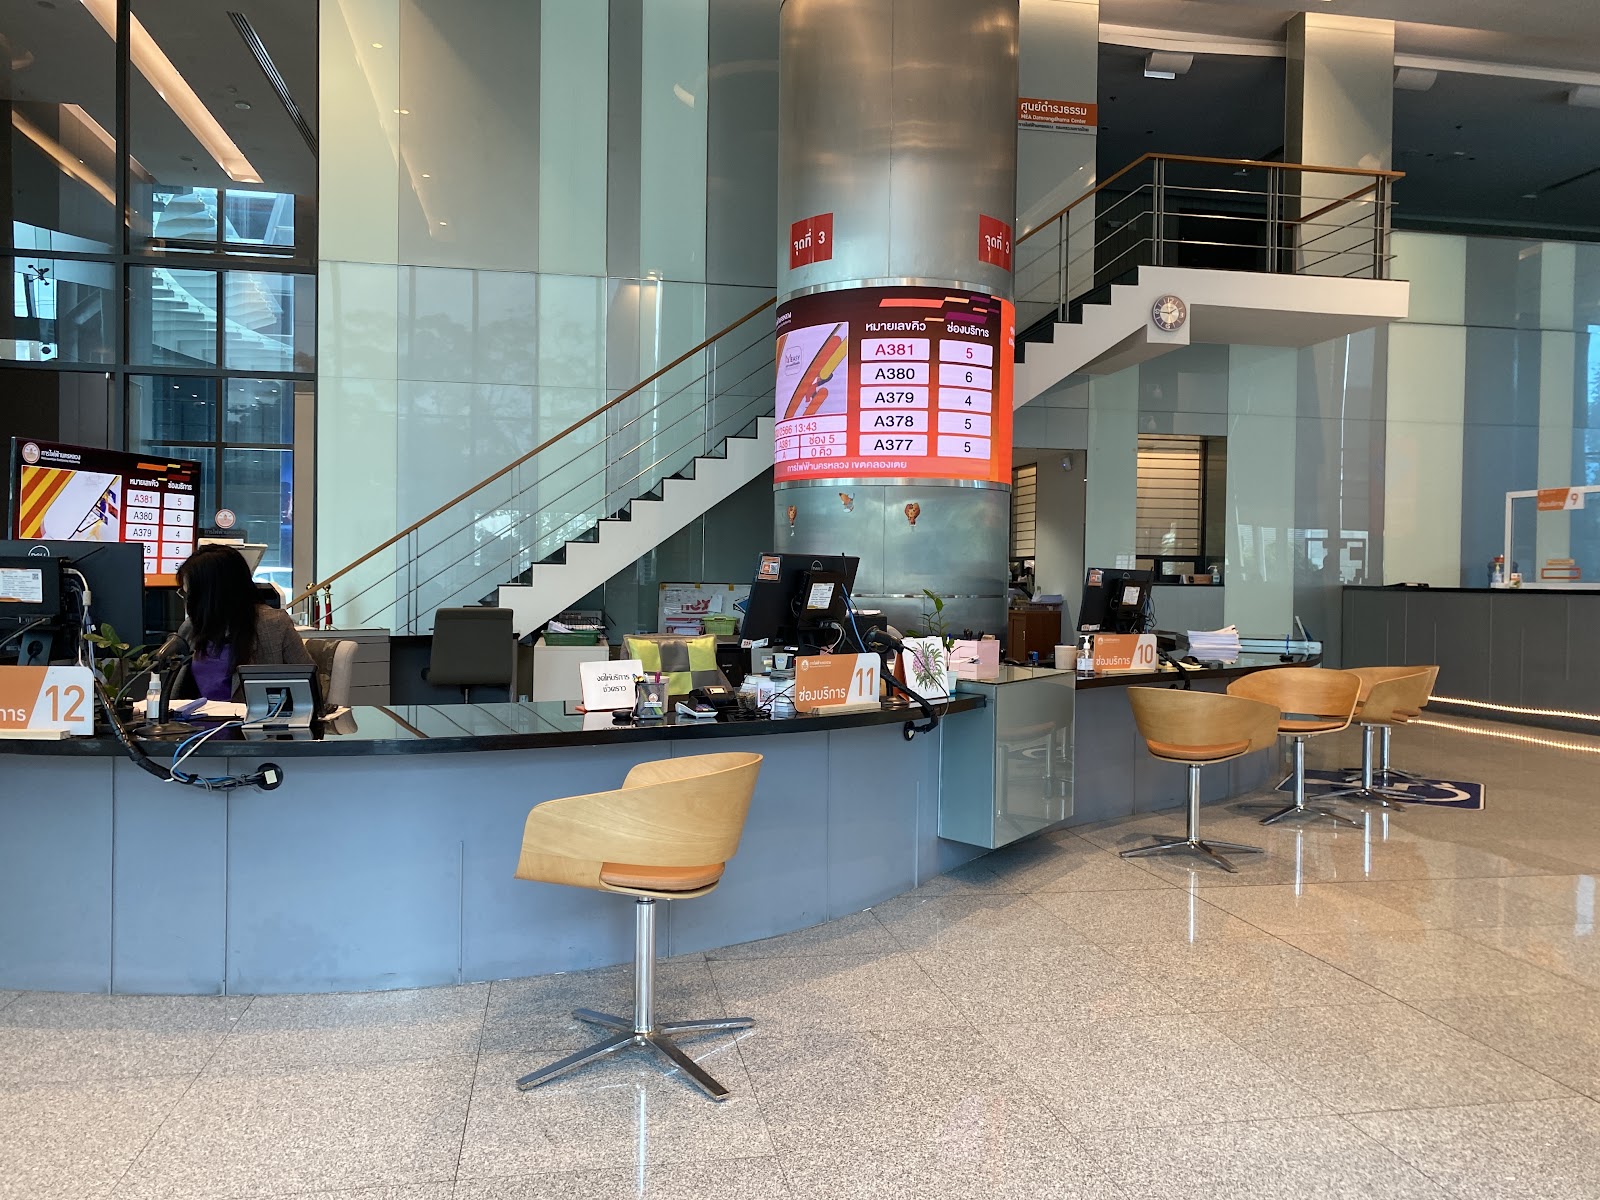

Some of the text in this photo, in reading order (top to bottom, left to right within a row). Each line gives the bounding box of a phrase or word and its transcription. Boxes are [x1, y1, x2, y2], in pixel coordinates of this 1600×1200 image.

[1021, 101, 1087, 116] ศูนย์ดำรงธรรม
[794, 228, 826, 256] จุดที่ 3
[984, 232, 1010, 254] จุดที่ 3
[865, 320, 926, 332] หมายเลขคิว
[946, 321, 990, 338] ช่องบริการ
[875, 343, 914, 356] A381
[966, 347, 973, 359] 5
[875, 368, 915, 380] A380
[965, 371, 973, 383] 6
[875, 392, 914, 404] A379
[964, 395, 972, 406] 4
[794, 421, 817, 433] 13:43
[874, 415, 914, 427] A378
[964, 418, 972, 430] 5
[809, 433, 835, 445] ช่อง 5
[874, 439, 914, 451] A377
[811, 446, 832, 457] 0 คิว
[964, 441, 971, 453] 5
[787, 460, 907, 472] การไฟฟ้านครหลวง เขตคลองเตย
[134, 494, 153, 504] A381
[177, 498, 182, 506] 5
[1571, 493, 1579, 506] 9
[133, 511, 153, 520] A380
[176, 514, 181, 523] 6
[133, 528, 152, 538] A379
[175, 530, 180, 538] 4
[175, 546, 180, 555] 5
[174, 562, 179, 571] 5
[1096, 655, 1131, 666] ช่องบริการ
[1137, 644, 1154, 665] 10
[855, 667, 874, 697] 11
[799, 686, 846, 702] ช่องบริการ
[45, 685, 85, 722] 12
